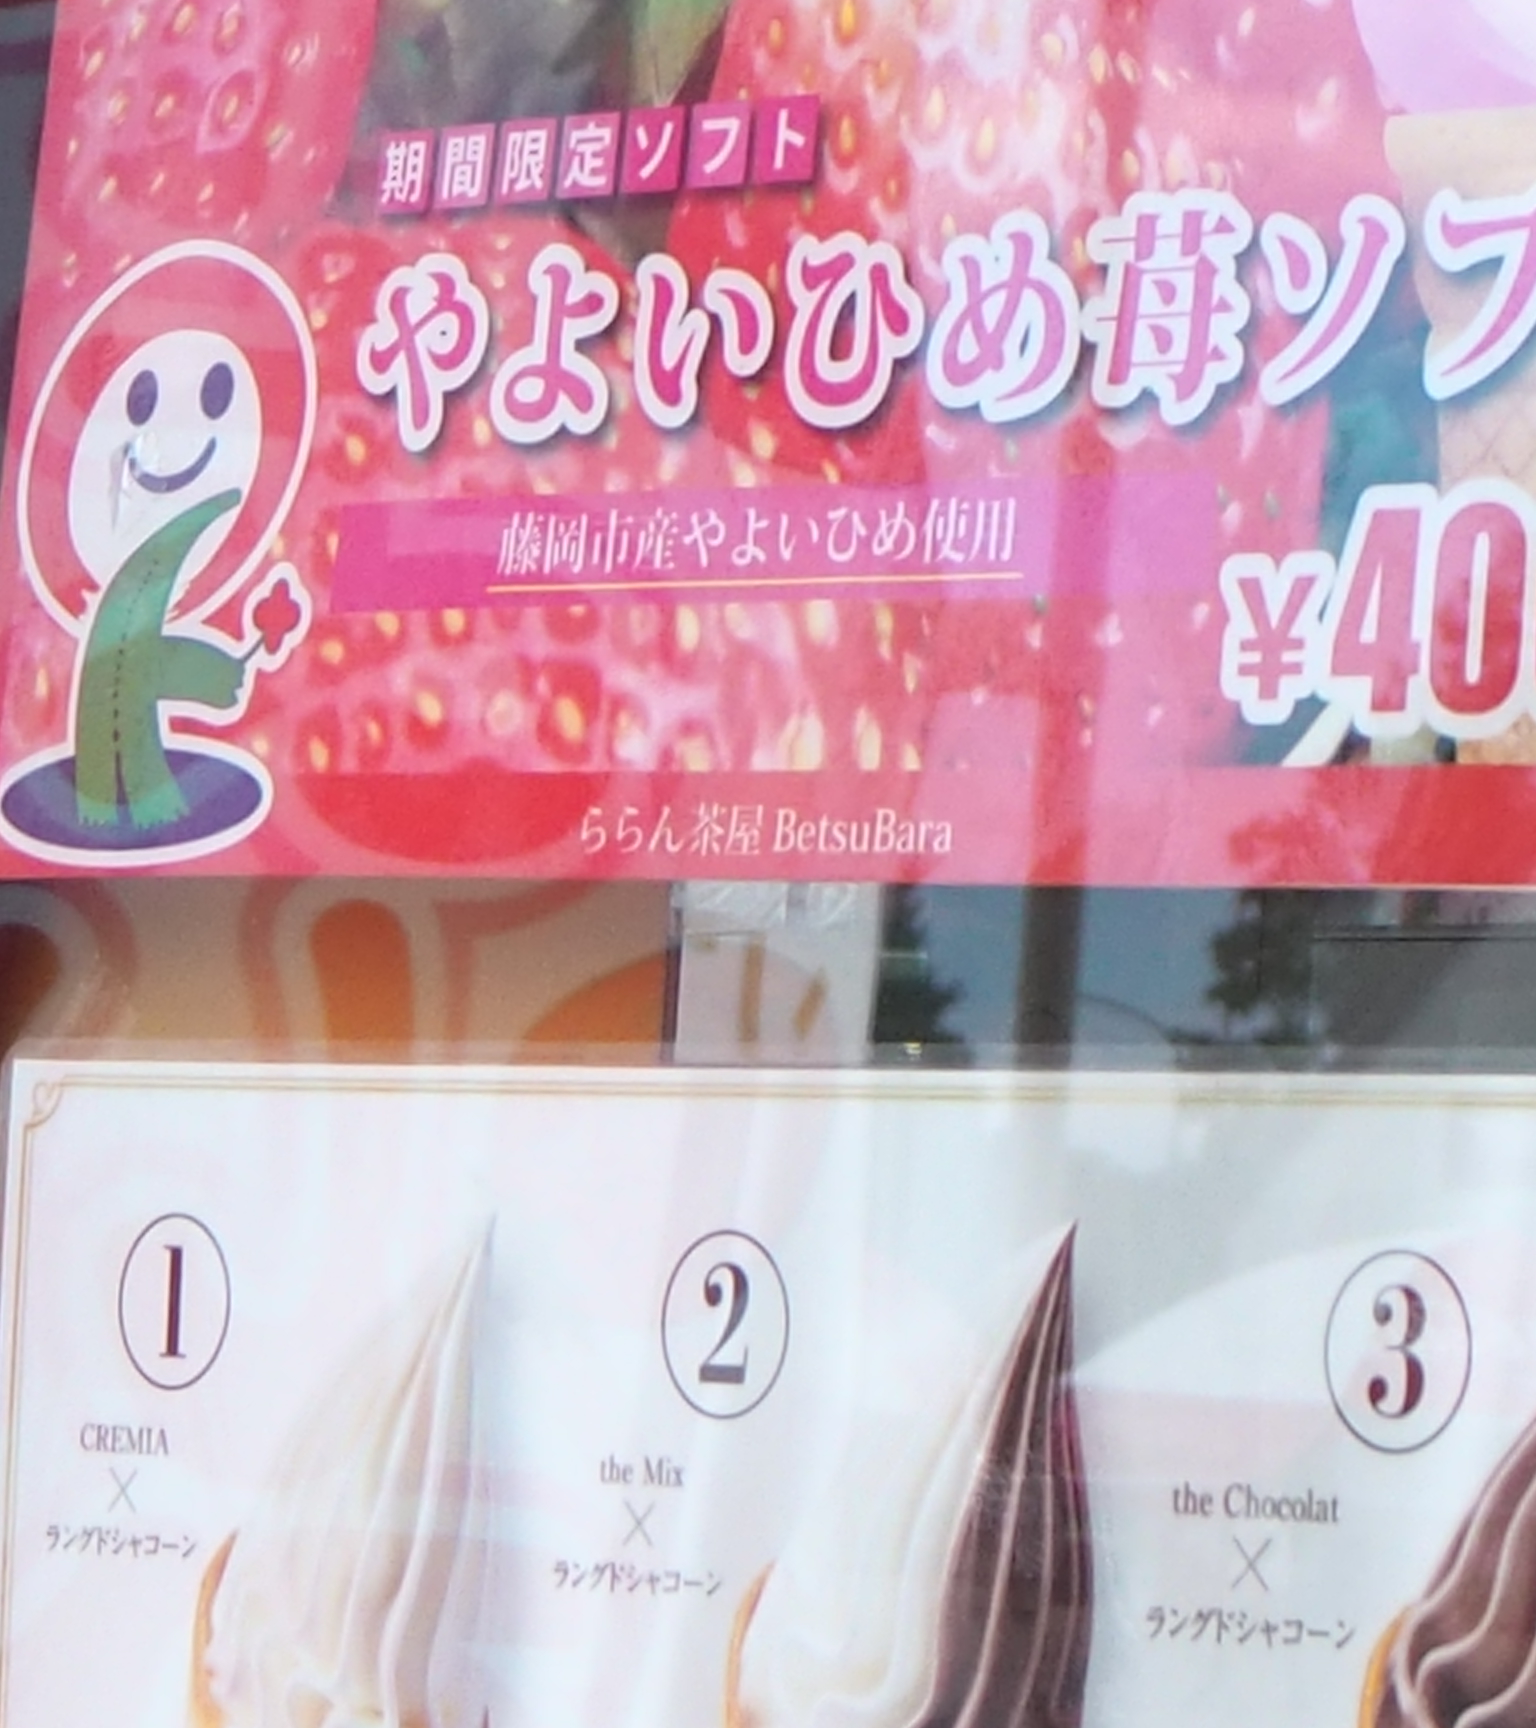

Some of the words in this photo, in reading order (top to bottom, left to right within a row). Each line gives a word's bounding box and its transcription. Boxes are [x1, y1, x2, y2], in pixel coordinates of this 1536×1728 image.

[381, 108, 806, 203] 期間限定ソフト
[499, 497, 1016, 575] 藤岡市産やよいひめ使用
[580, 803, 763, 857] ららん茶屋
[774, 806, 953, 855] BetsuBara
[80, 1422, 169, 1455] CREMIA
[600, 1454, 633, 1484] the
[643, 1455, 684, 1487] Mix
[1173, 1481, 1213, 1517] the
[1223, 1483, 1339, 1523] Chocolat
[47, 1525, 196, 1558] ラングドシャコーン
[554, 1559, 722, 1596] ラングドシャコーン
[1147, 1606, 1356, 1650] ラングドシャコーン
